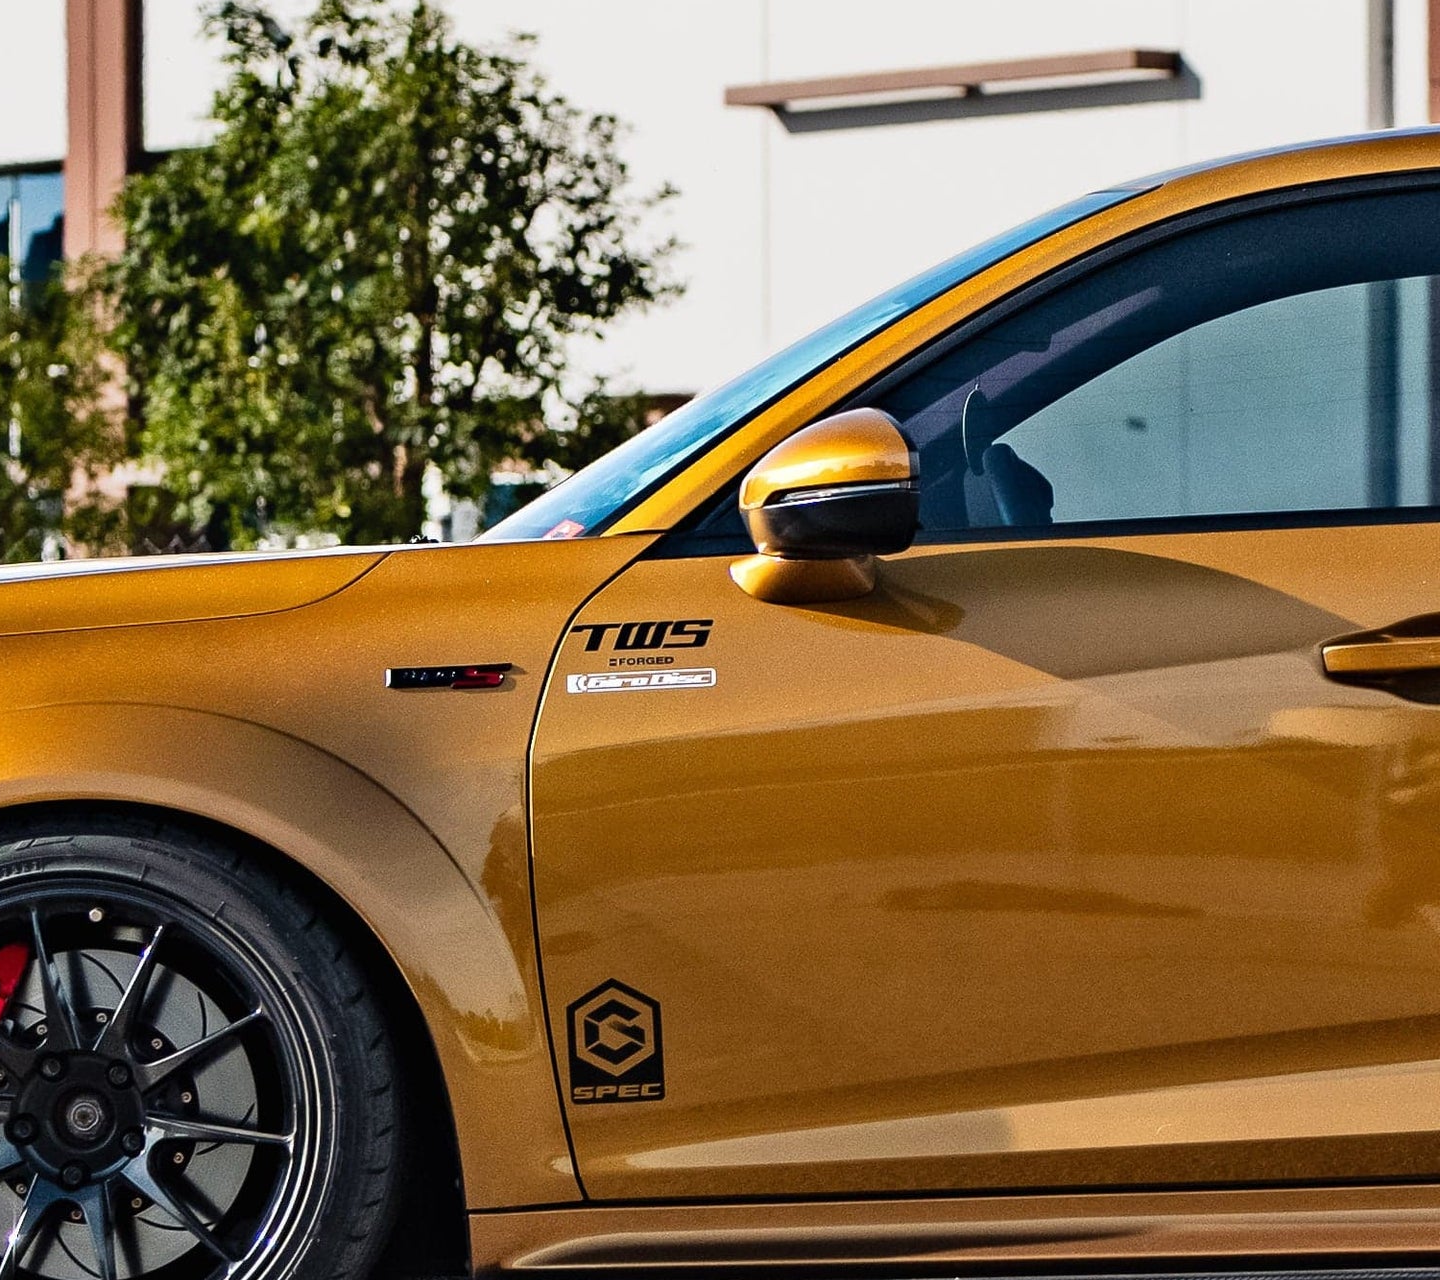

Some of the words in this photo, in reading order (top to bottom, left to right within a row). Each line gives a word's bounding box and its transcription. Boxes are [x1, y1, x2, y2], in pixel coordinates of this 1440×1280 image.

[570, 619, 714, 652] TWS
[619, 656, 675, 666] FORGED
[573, 1083, 661, 1100] SPEC
